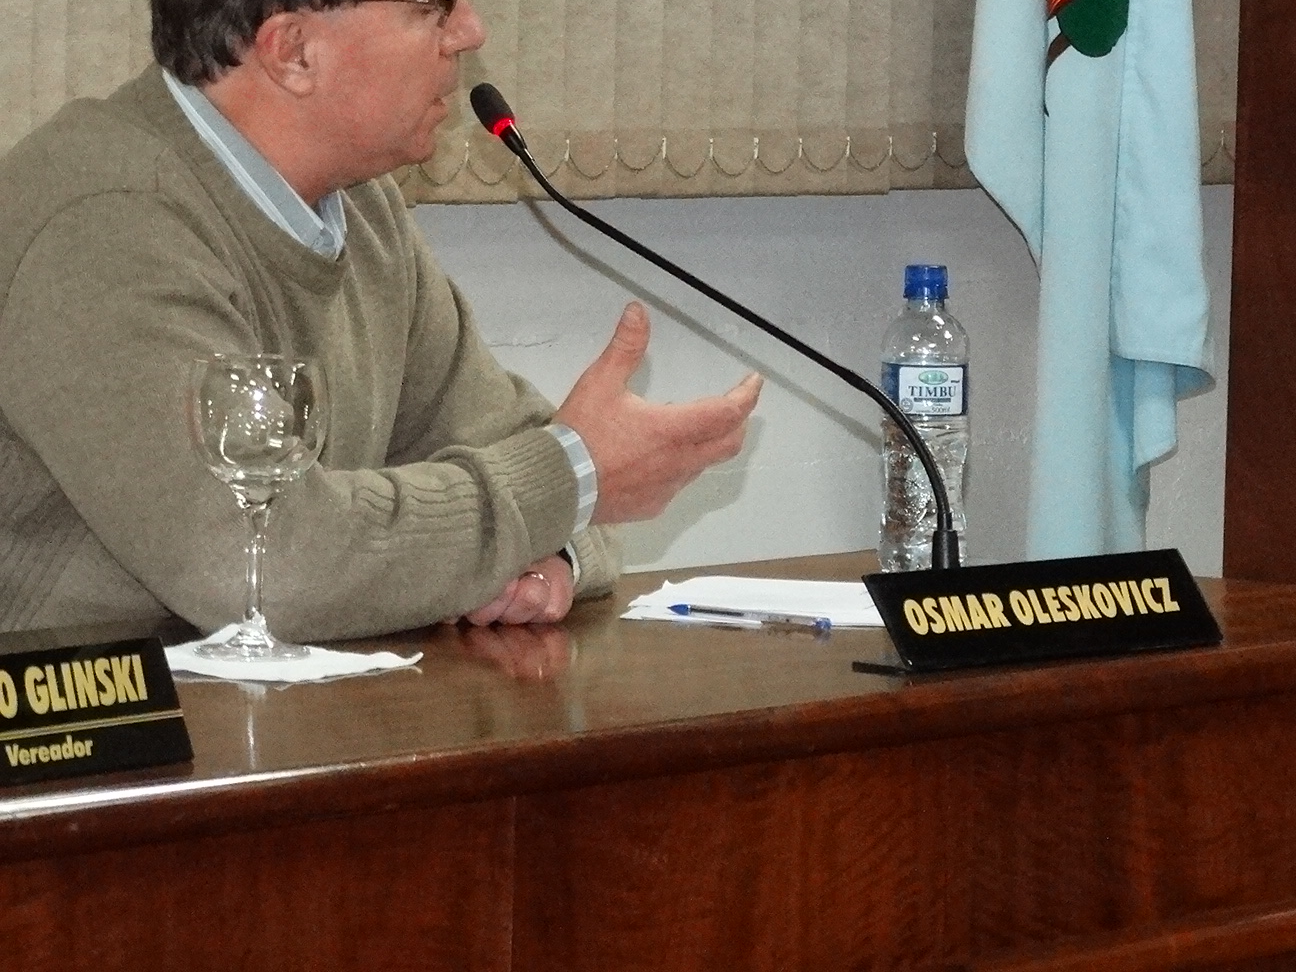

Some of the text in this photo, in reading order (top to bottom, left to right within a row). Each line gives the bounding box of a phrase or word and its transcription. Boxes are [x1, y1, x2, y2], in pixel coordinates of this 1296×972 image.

[903, 577, 1180, 636] OSMAR OLESKOVICZ
[24, 654, 148, 715] GLINSKI
[5, 735, 94, 767] Vereador
